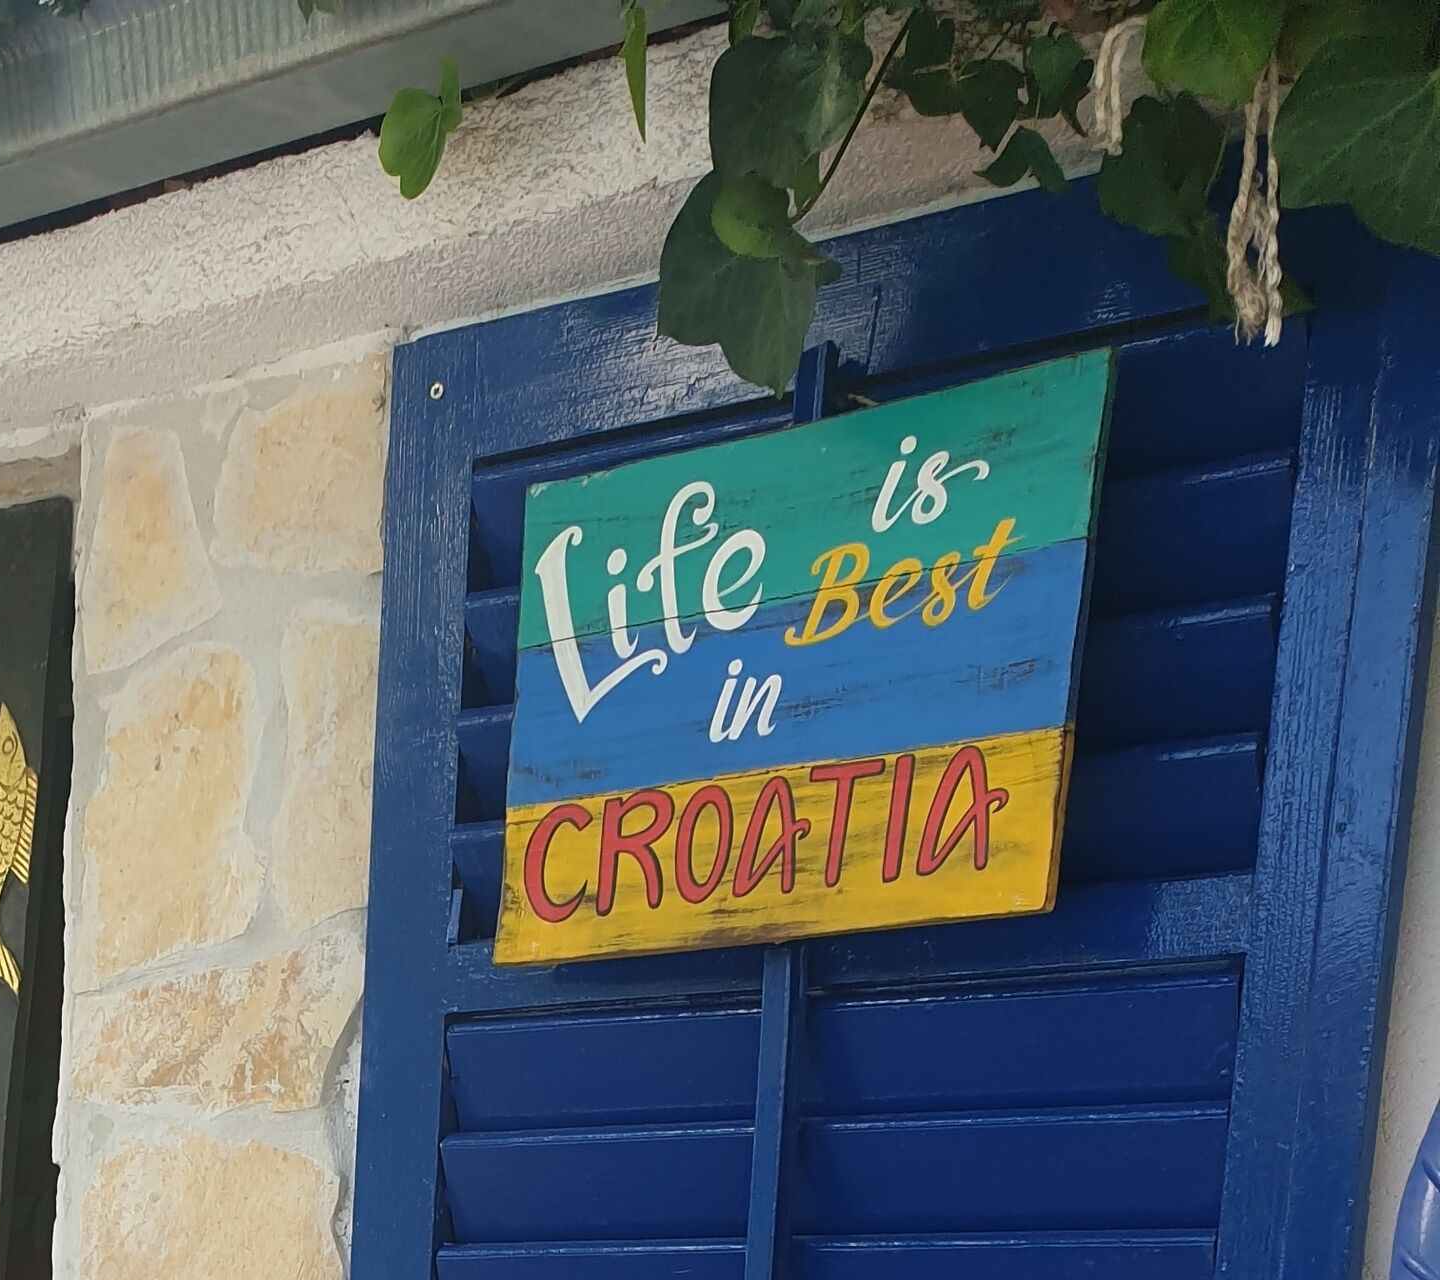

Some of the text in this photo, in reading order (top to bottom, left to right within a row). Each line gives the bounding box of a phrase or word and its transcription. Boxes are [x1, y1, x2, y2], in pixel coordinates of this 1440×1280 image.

[534, 435, 990, 723] Life is
[784, 517, 1025, 647] Best
[709, 658, 783, 744] in
[523, 744, 1009, 924] CROATIA
